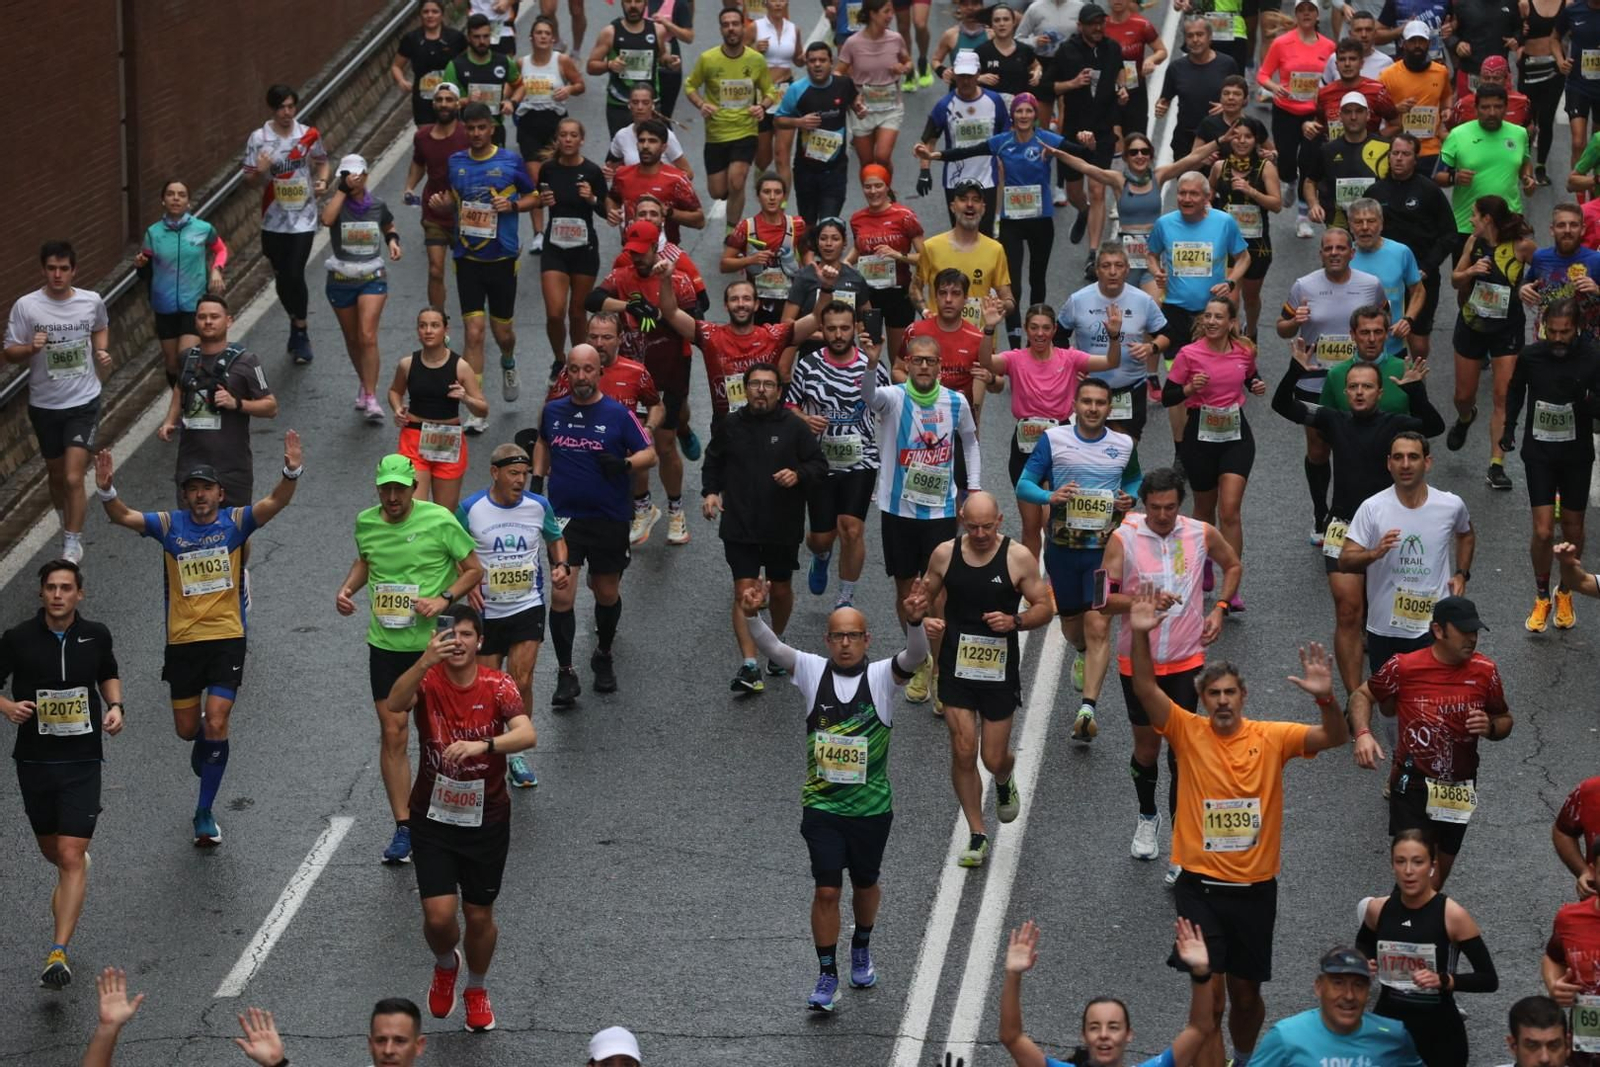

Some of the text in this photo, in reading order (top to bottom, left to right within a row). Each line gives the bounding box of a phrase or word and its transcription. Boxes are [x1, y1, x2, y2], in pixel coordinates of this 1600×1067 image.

[1406, 114, 1431, 124] 12407
[960, 124, 982, 135] 8615
[811, 136, 838, 149] 13744
[1342, 187, 1365, 197] 7420
[466, 211, 489, 222] 4077
[1181, 250, 1205, 262] 12271
[52, 347, 79, 363] 9661
[1321, 344, 1353, 356] 14446
[1539, 411, 1565, 426] 6763
[551, 436, 603, 451] MADRID
[826, 444, 853, 456] 7129
[912, 472, 942, 490] 6982
[1070, 498, 1107, 512] 10645
[183, 559, 223, 577] 11103
[1400, 557, 1424, 566] TRAIL
[492, 570, 529, 586] 12355
[375, 595, 410, 610] 12198
[1397, 597, 1431, 614] 13095
[962, 645, 1000, 663] 12297
[40, 700, 83, 716] 12073
[819, 746, 860, 763] 14483
[436, 788, 475, 807] 15408
[1433, 785, 1470, 803] 13683
[1207, 812, 1251, 829] 11339
